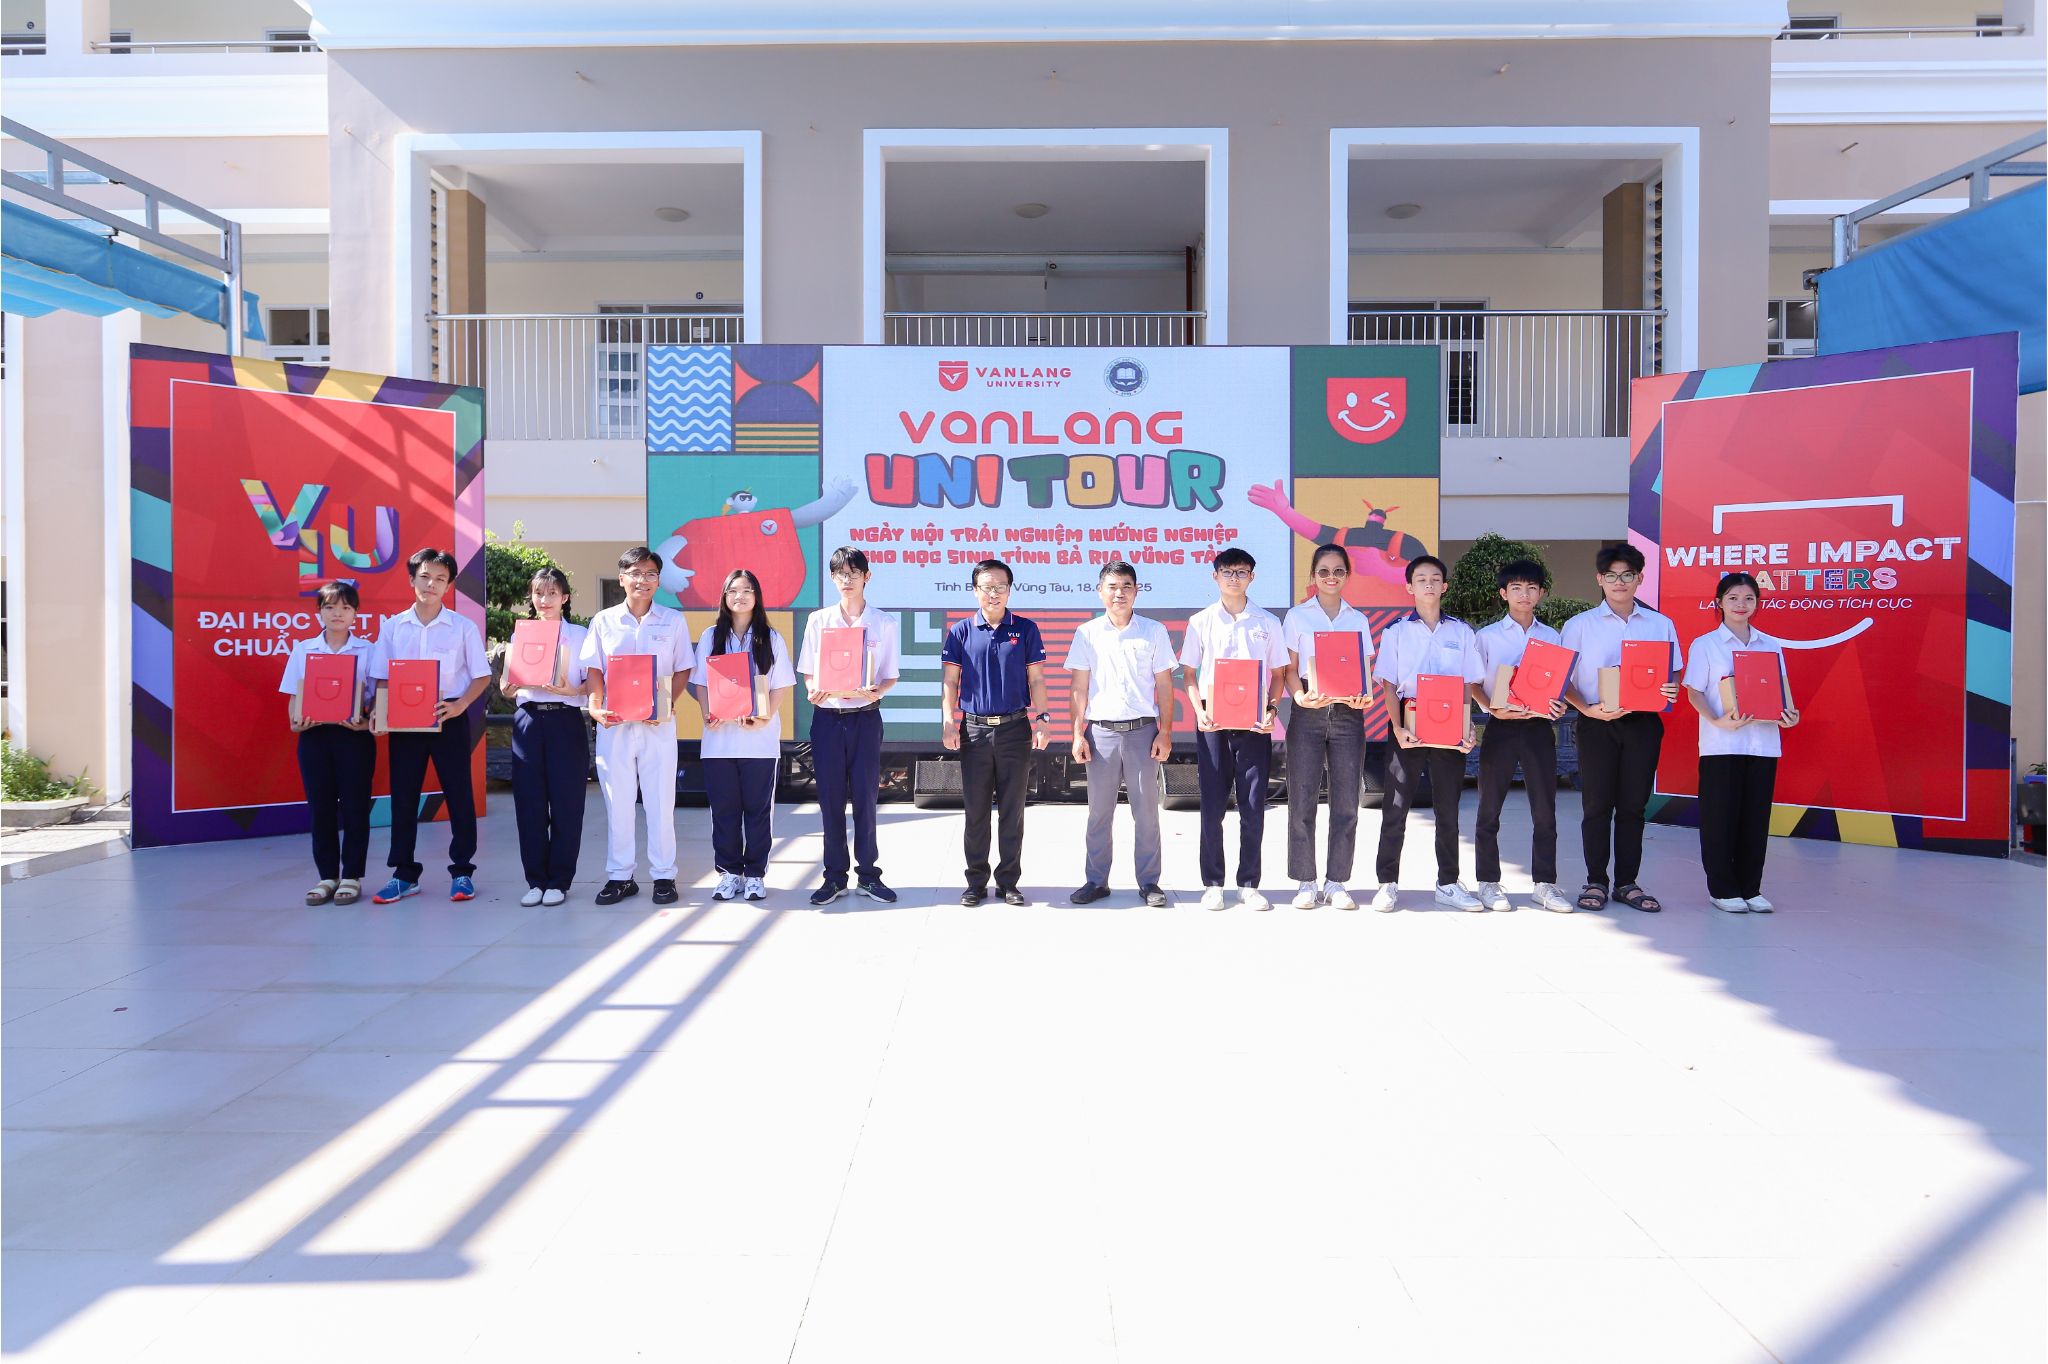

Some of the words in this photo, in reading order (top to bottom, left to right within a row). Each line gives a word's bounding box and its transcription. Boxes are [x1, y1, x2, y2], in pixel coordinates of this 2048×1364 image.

[976, 367, 1071, 378] VANLANG
[987, 380, 1061, 388] UNIVERSITY
[850, 522, 904, 542] NGÀY
[911, 522, 944, 546] HỘI
[950, 522, 999, 542] TRẢI
[1005, 523, 1083, 545] NGHIỆM
[1089, 522, 1158, 543] HƯỚNG
[1164, 522, 1238, 545] NGHIỆP
[902, 549, 942, 568] HỌC
[947, 549, 995, 565] SINH
[1001, 546, 1050, 564] TỈNH
[1056, 545, 1083, 565] BÀ
[1129, 545, 1185, 565] VŨNG
[1191, 544, 1224, 564] TÀ
[1665, 543, 1789, 568] WHERE
[1807, 536, 1962, 563] IMPACT
[1013, 582, 1047, 595] Vũng
[1049, 582, 1074, 593] Tàu,
[1720, 567, 1898, 591] ATTERS
[1760, 597, 1787, 609] TÁC
[1789, 597, 1834, 611] ĐỘNG
[1838, 596, 1874, 609] TÍCH
[1876, 597, 1913, 610] CỰC
[197, 611, 245, 633] ĐẠI
[253, 611, 311, 633] HỌC
